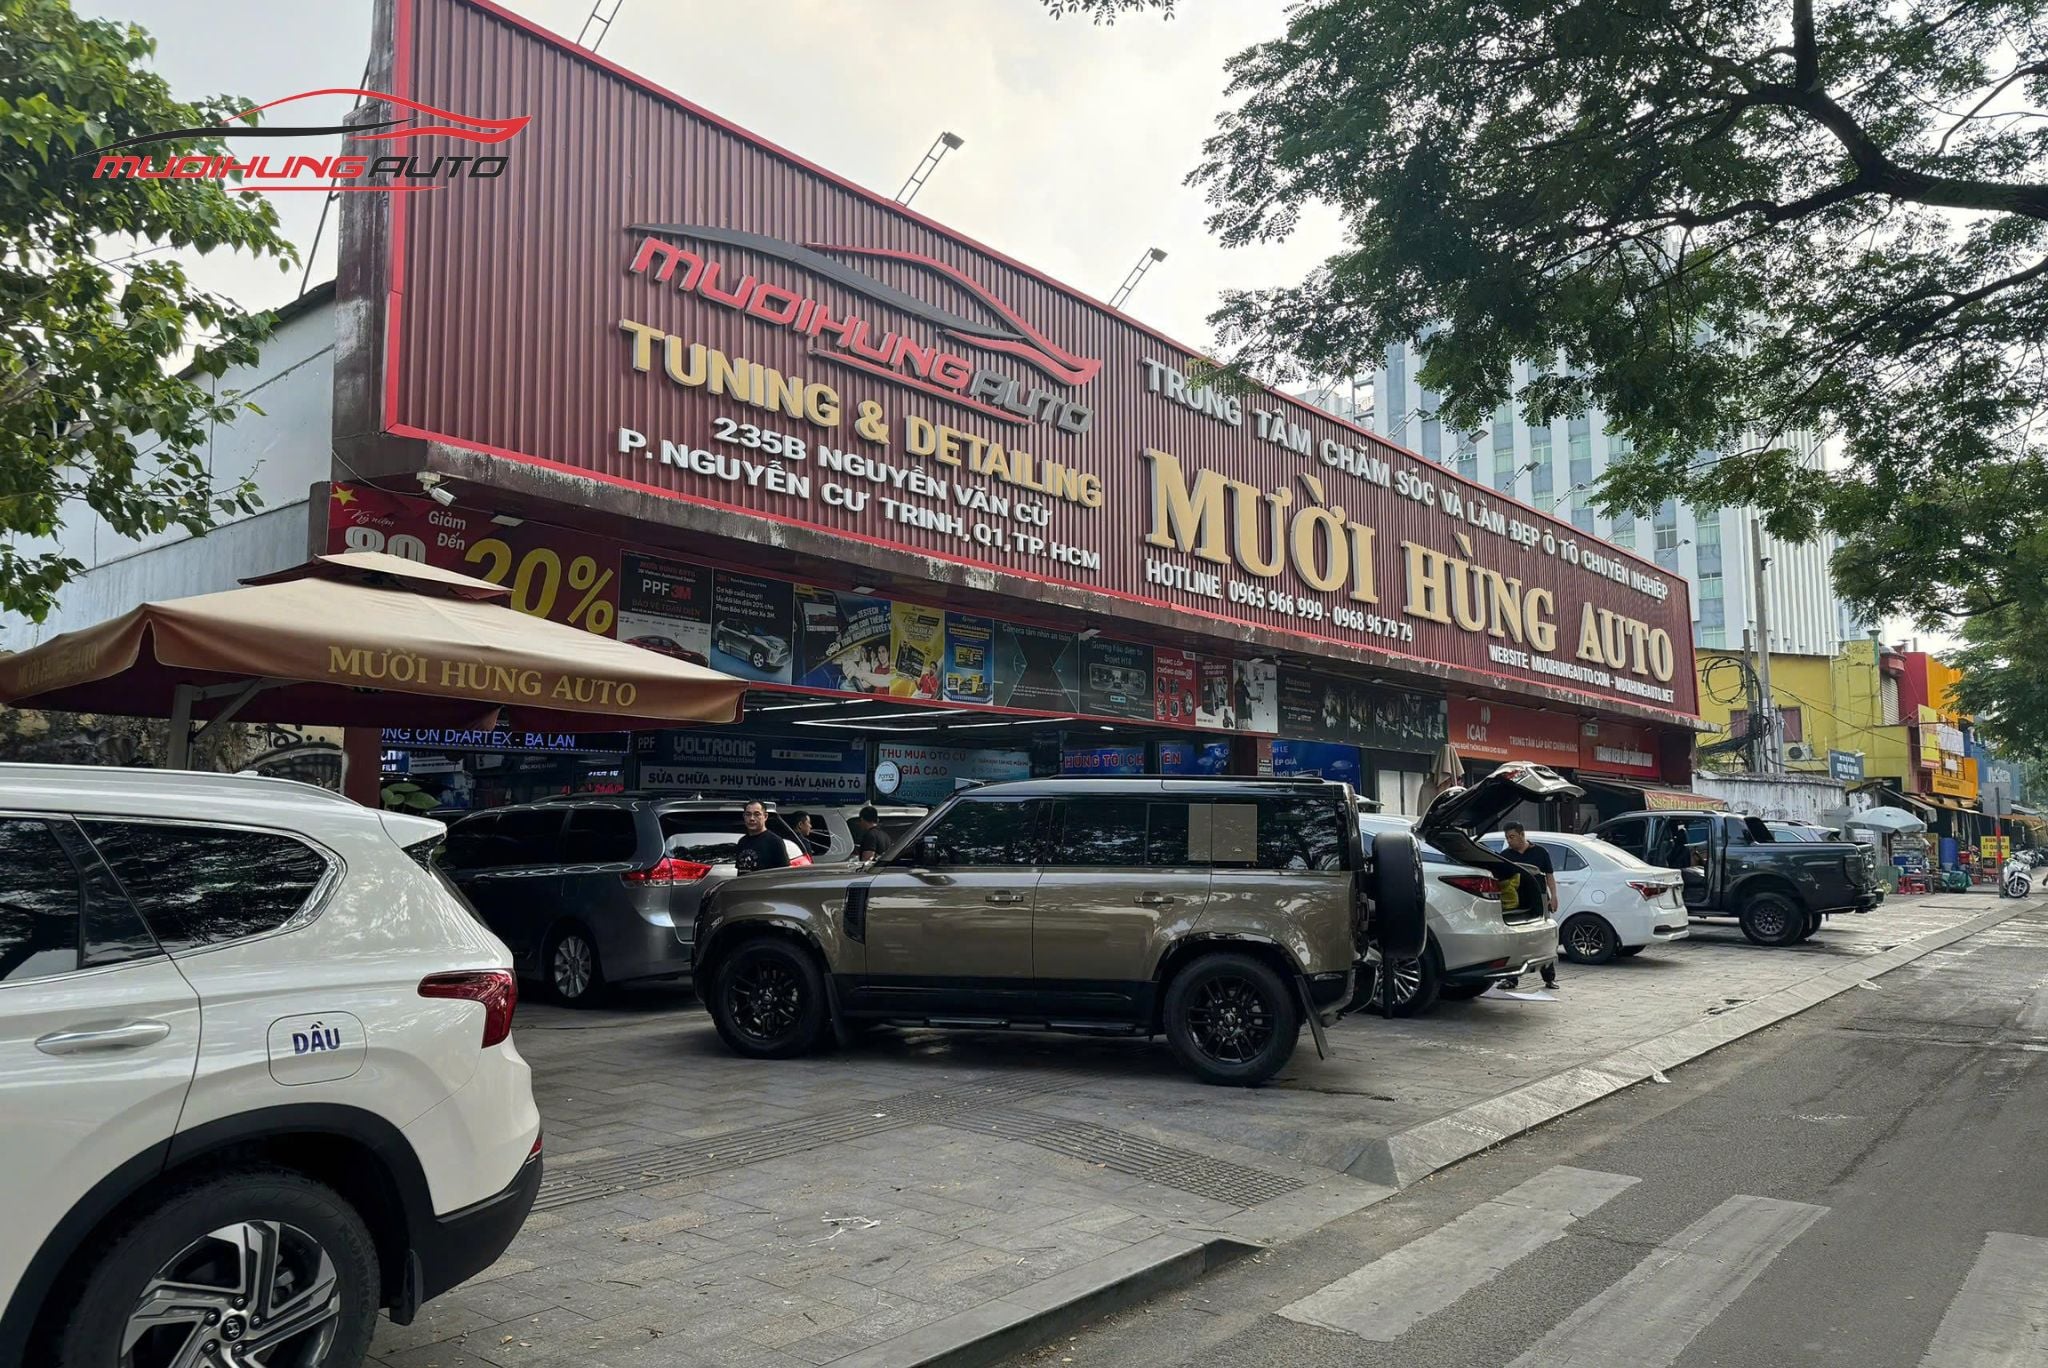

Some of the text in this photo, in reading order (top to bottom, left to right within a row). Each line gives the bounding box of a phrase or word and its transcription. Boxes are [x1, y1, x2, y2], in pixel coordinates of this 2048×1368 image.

[618, 318, 1102, 509] TUNING & DETAILING
[618, 426, 653, 459] P.
[659, 438, 810, 499] NGUYỄN
[820, 482, 871, 512] CƯ
[712, 416, 807, 460] 235B
[953, 483, 1009, 518] VĂN
[1014, 500, 1053, 527] CỪ
[1143, 357, 1242, 426] TRUNG
[1253, 408, 1311, 456] TÂM
[1320, 438, 1390, 488] CHĂM
[1438, 485, 1465, 519] VÀ
[1467, 499, 1506, 536] LÀM
[1509, 519, 1541, 551] ĐẸP
[1543, 528, 1556, 555] Ô
[1558, 538, 1580, 565] TÔ
[1580, 549, 1630, 586] CHUYÊN
[1631, 570, 1669, 604] NGHIỆP
[428, 511, 467, 530] Giảm
[437, 532, 466, 550] Đến
[1144, 448, 1674, 683] MƯỜI HÙNG AUTO
[464, 538, 615, 634] 20%
[642, 578, 692, 600] PPF 3M
[1230, 579, 1265, 609] 0965
[1268, 590, 1294, 615] 966
[1297, 598, 1323, 621] 999
[1333, 606, 1365, 632] 0968
[328, 645, 637, 707] MƯỜI HÙNG AUTO
[445, 731, 512, 745] DrARTEX
[525, 732, 544, 747] BA
[548, 734, 575, 748] LAN
[638, 736, 656, 749] PPF
[1466, 723, 1487, 742] ICAR
[673, 736, 756, 757] VOLTRONIC
[880, 748, 902, 759] THU
[904, 750, 927, 759] MUA
[648, 769, 673, 784] SỬA
[677, 771, 710, 785] CHỮA
[720, 778, 744, 789] PHỤ
[746, 773, 777, 787] TÙNG
[785, 774, 806, 787] MÁY
[808, 779, 837, 791] LẠNH
[838, 776, 846, 788] Ô
[847, 776, 861, 789] TÔ
[923, 765, 948, 776] CAO
[292, 1020, 341, 1056] DẦU
